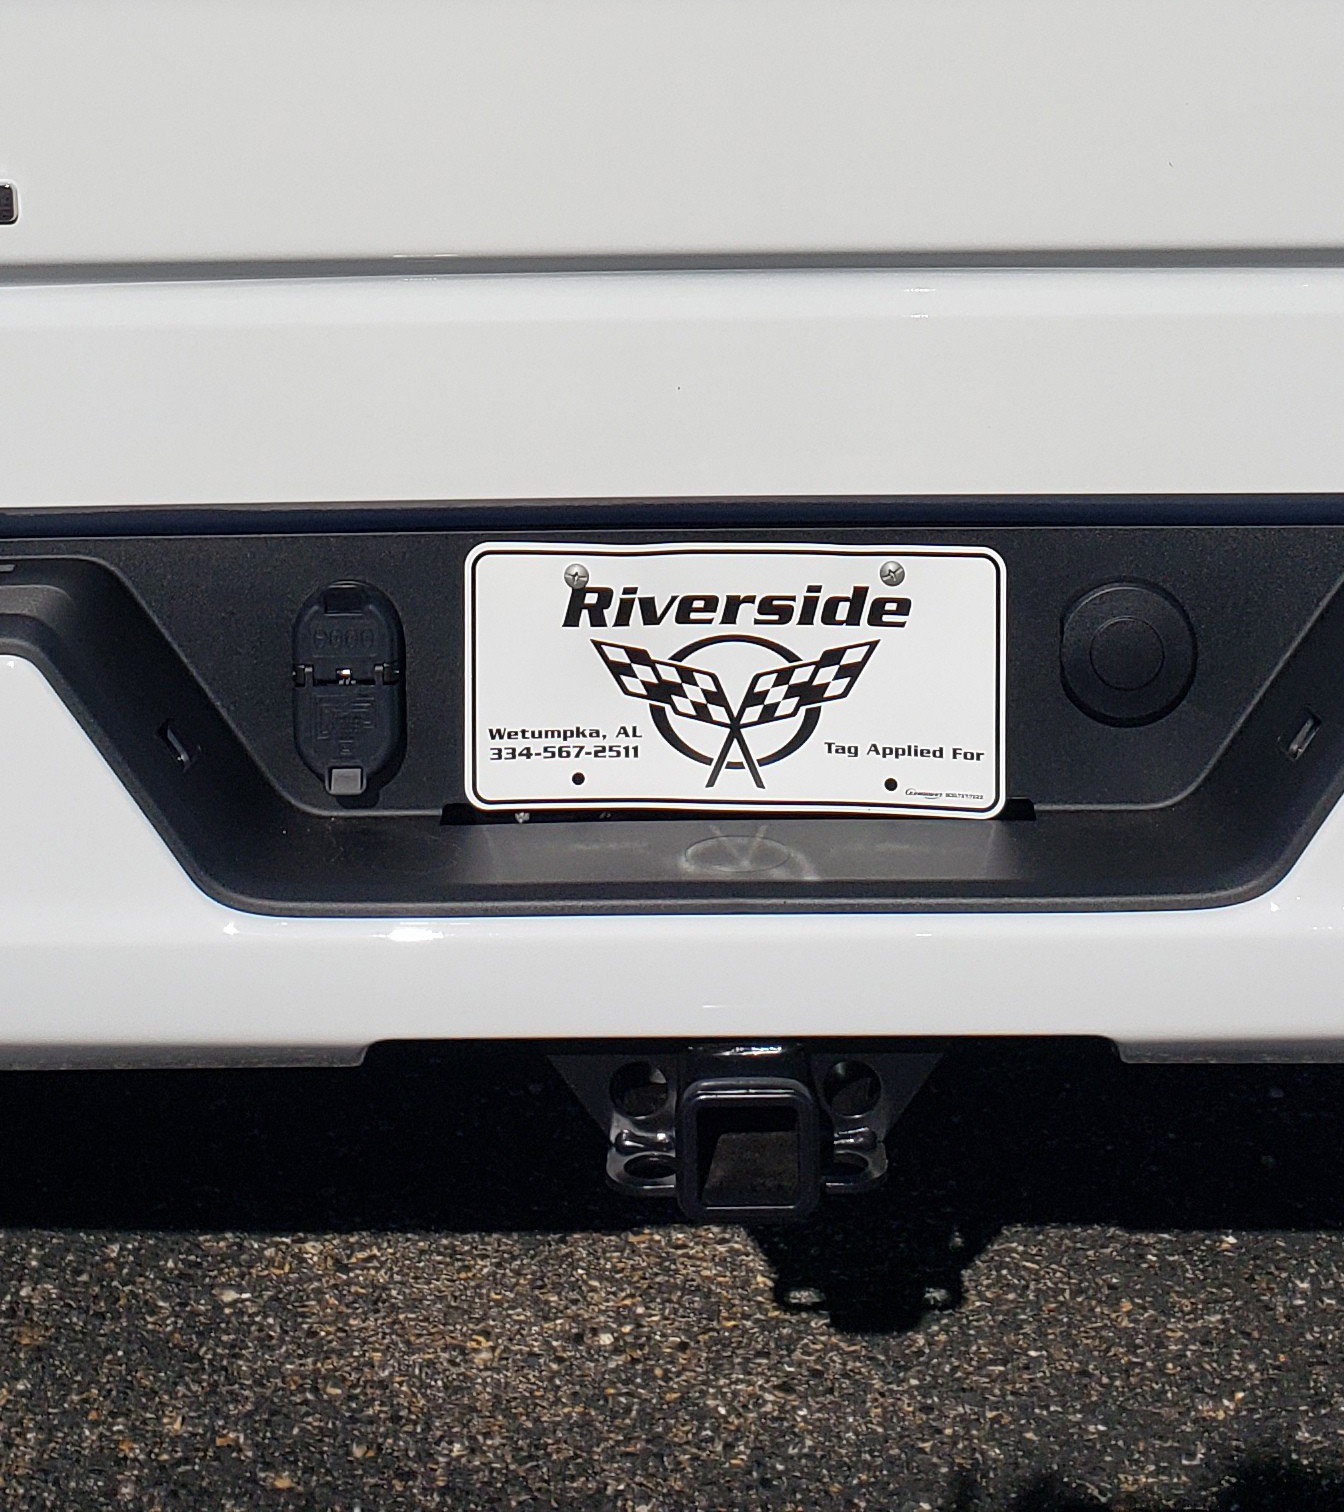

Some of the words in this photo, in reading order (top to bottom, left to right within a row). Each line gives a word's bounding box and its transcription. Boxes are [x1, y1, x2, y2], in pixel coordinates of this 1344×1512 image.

[561, 585, 912, 628] Riverside
[488, 726, 607, 742] Wetumpka,
[615, 725, 643, 738] AL
[489, 745, 639, 761] 334-567-2511
[824, 741, 859, 758] Tag
[866, 743, 944, 760] Applied
[952, 747, 985, 762] For
